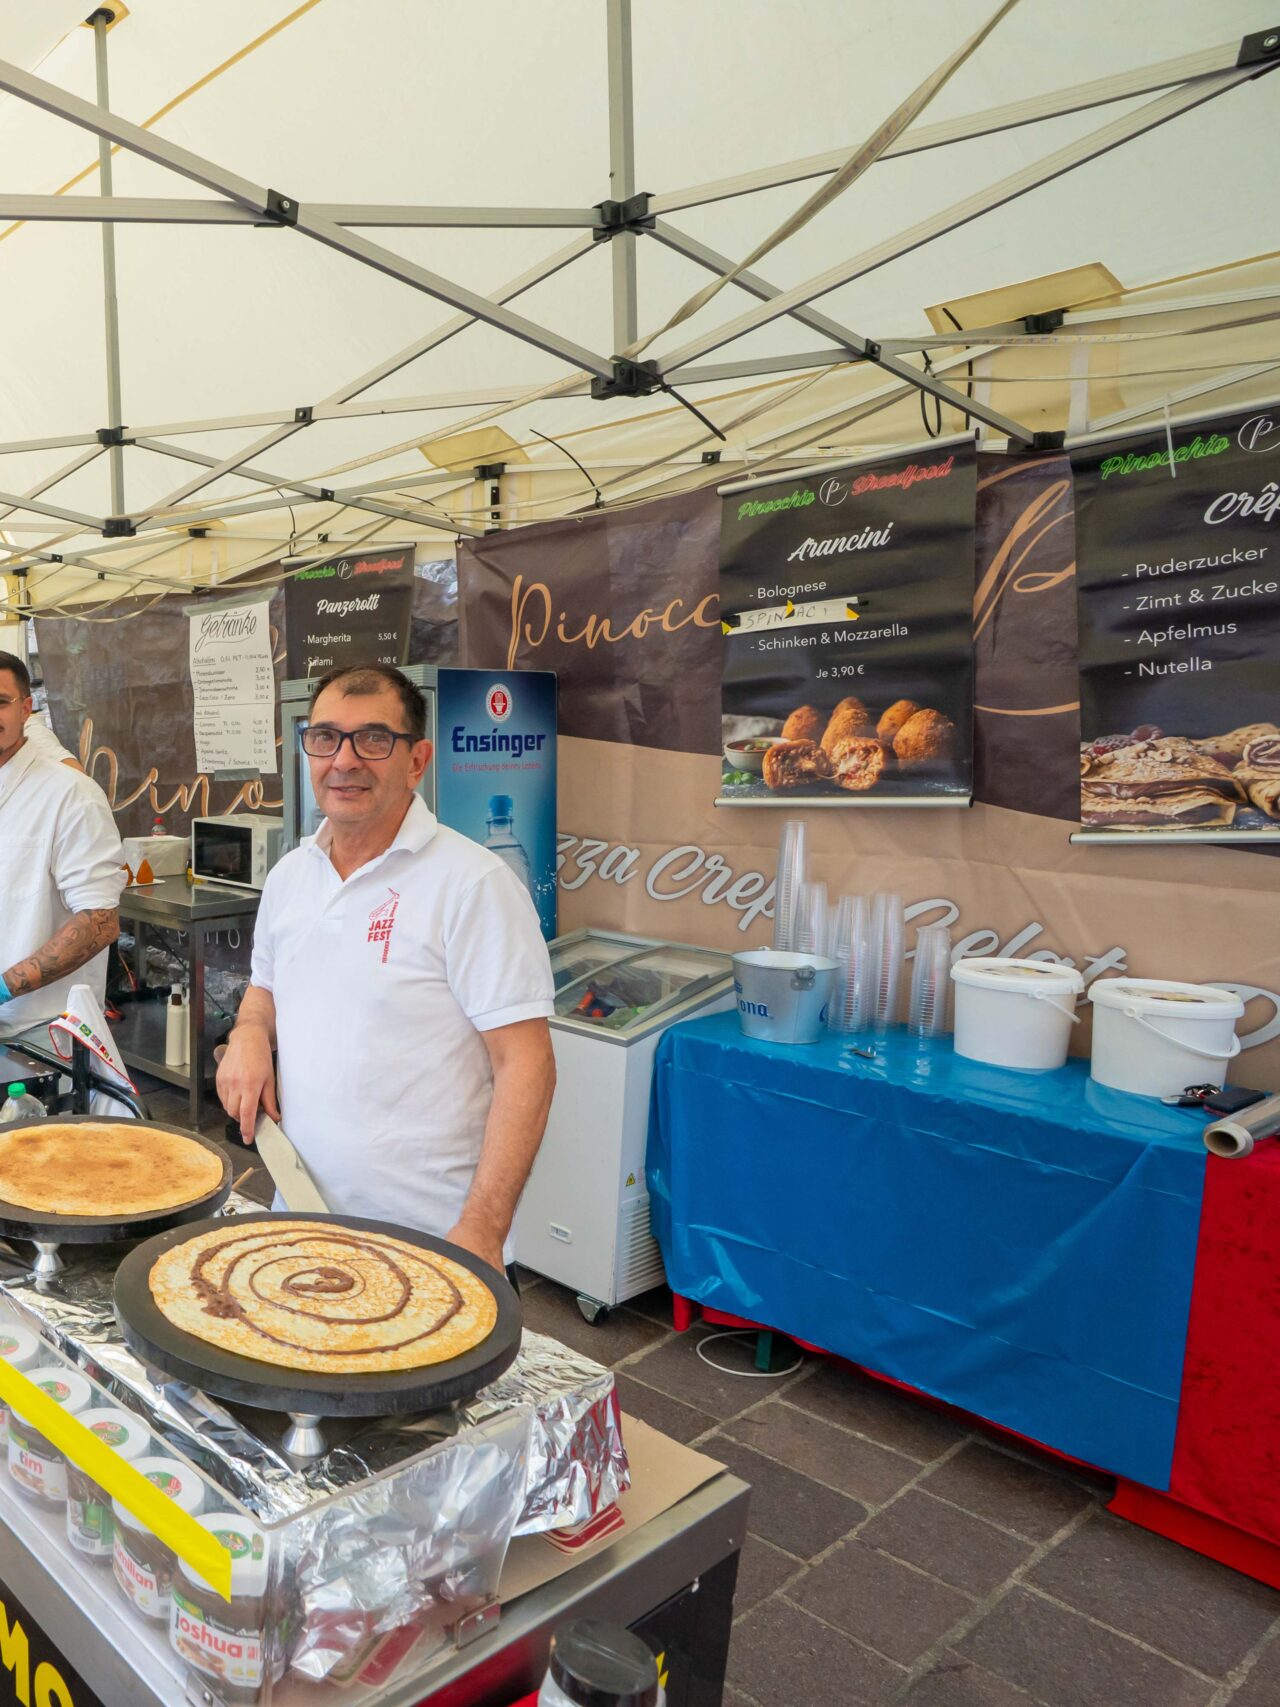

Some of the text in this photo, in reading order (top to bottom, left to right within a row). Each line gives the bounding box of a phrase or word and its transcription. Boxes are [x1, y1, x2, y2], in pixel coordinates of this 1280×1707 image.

[1101, 434, 1230, 480] Pinocchio
[738, 489, 816, 521] Pinocchio
[787, 522, 894, 562] Arancini
[1135, 547, 1268, 578] Puderzucker
[757, 580, 827, 599] Bolognese
[1135, 579, 1278, 611] Zimt & Zucke
[316, 593, 380, 617] Panzerotti
[195, 609, 257, 653] Getränke
[307, 633, 351, 646] Margherita
[393, 632, 397, 640] €
[758, 623, 908, 651] Schinken & Mozzarella
[1137, 622, 1237, 647] Apfelmus
[308, 656, 333, 667] Salami
[816, 664, 865, 679] Je 3,90 €
[1139, 656, 1212, 677] Nutella
[451, 726, 546, 758] Ensinger
[367, 930, 392, 943] FEST
[368, 919, 395, 931] JAZZ
[20, 1451, 43, 1475] tim
[175, 1606, 242, 1659] joshua
